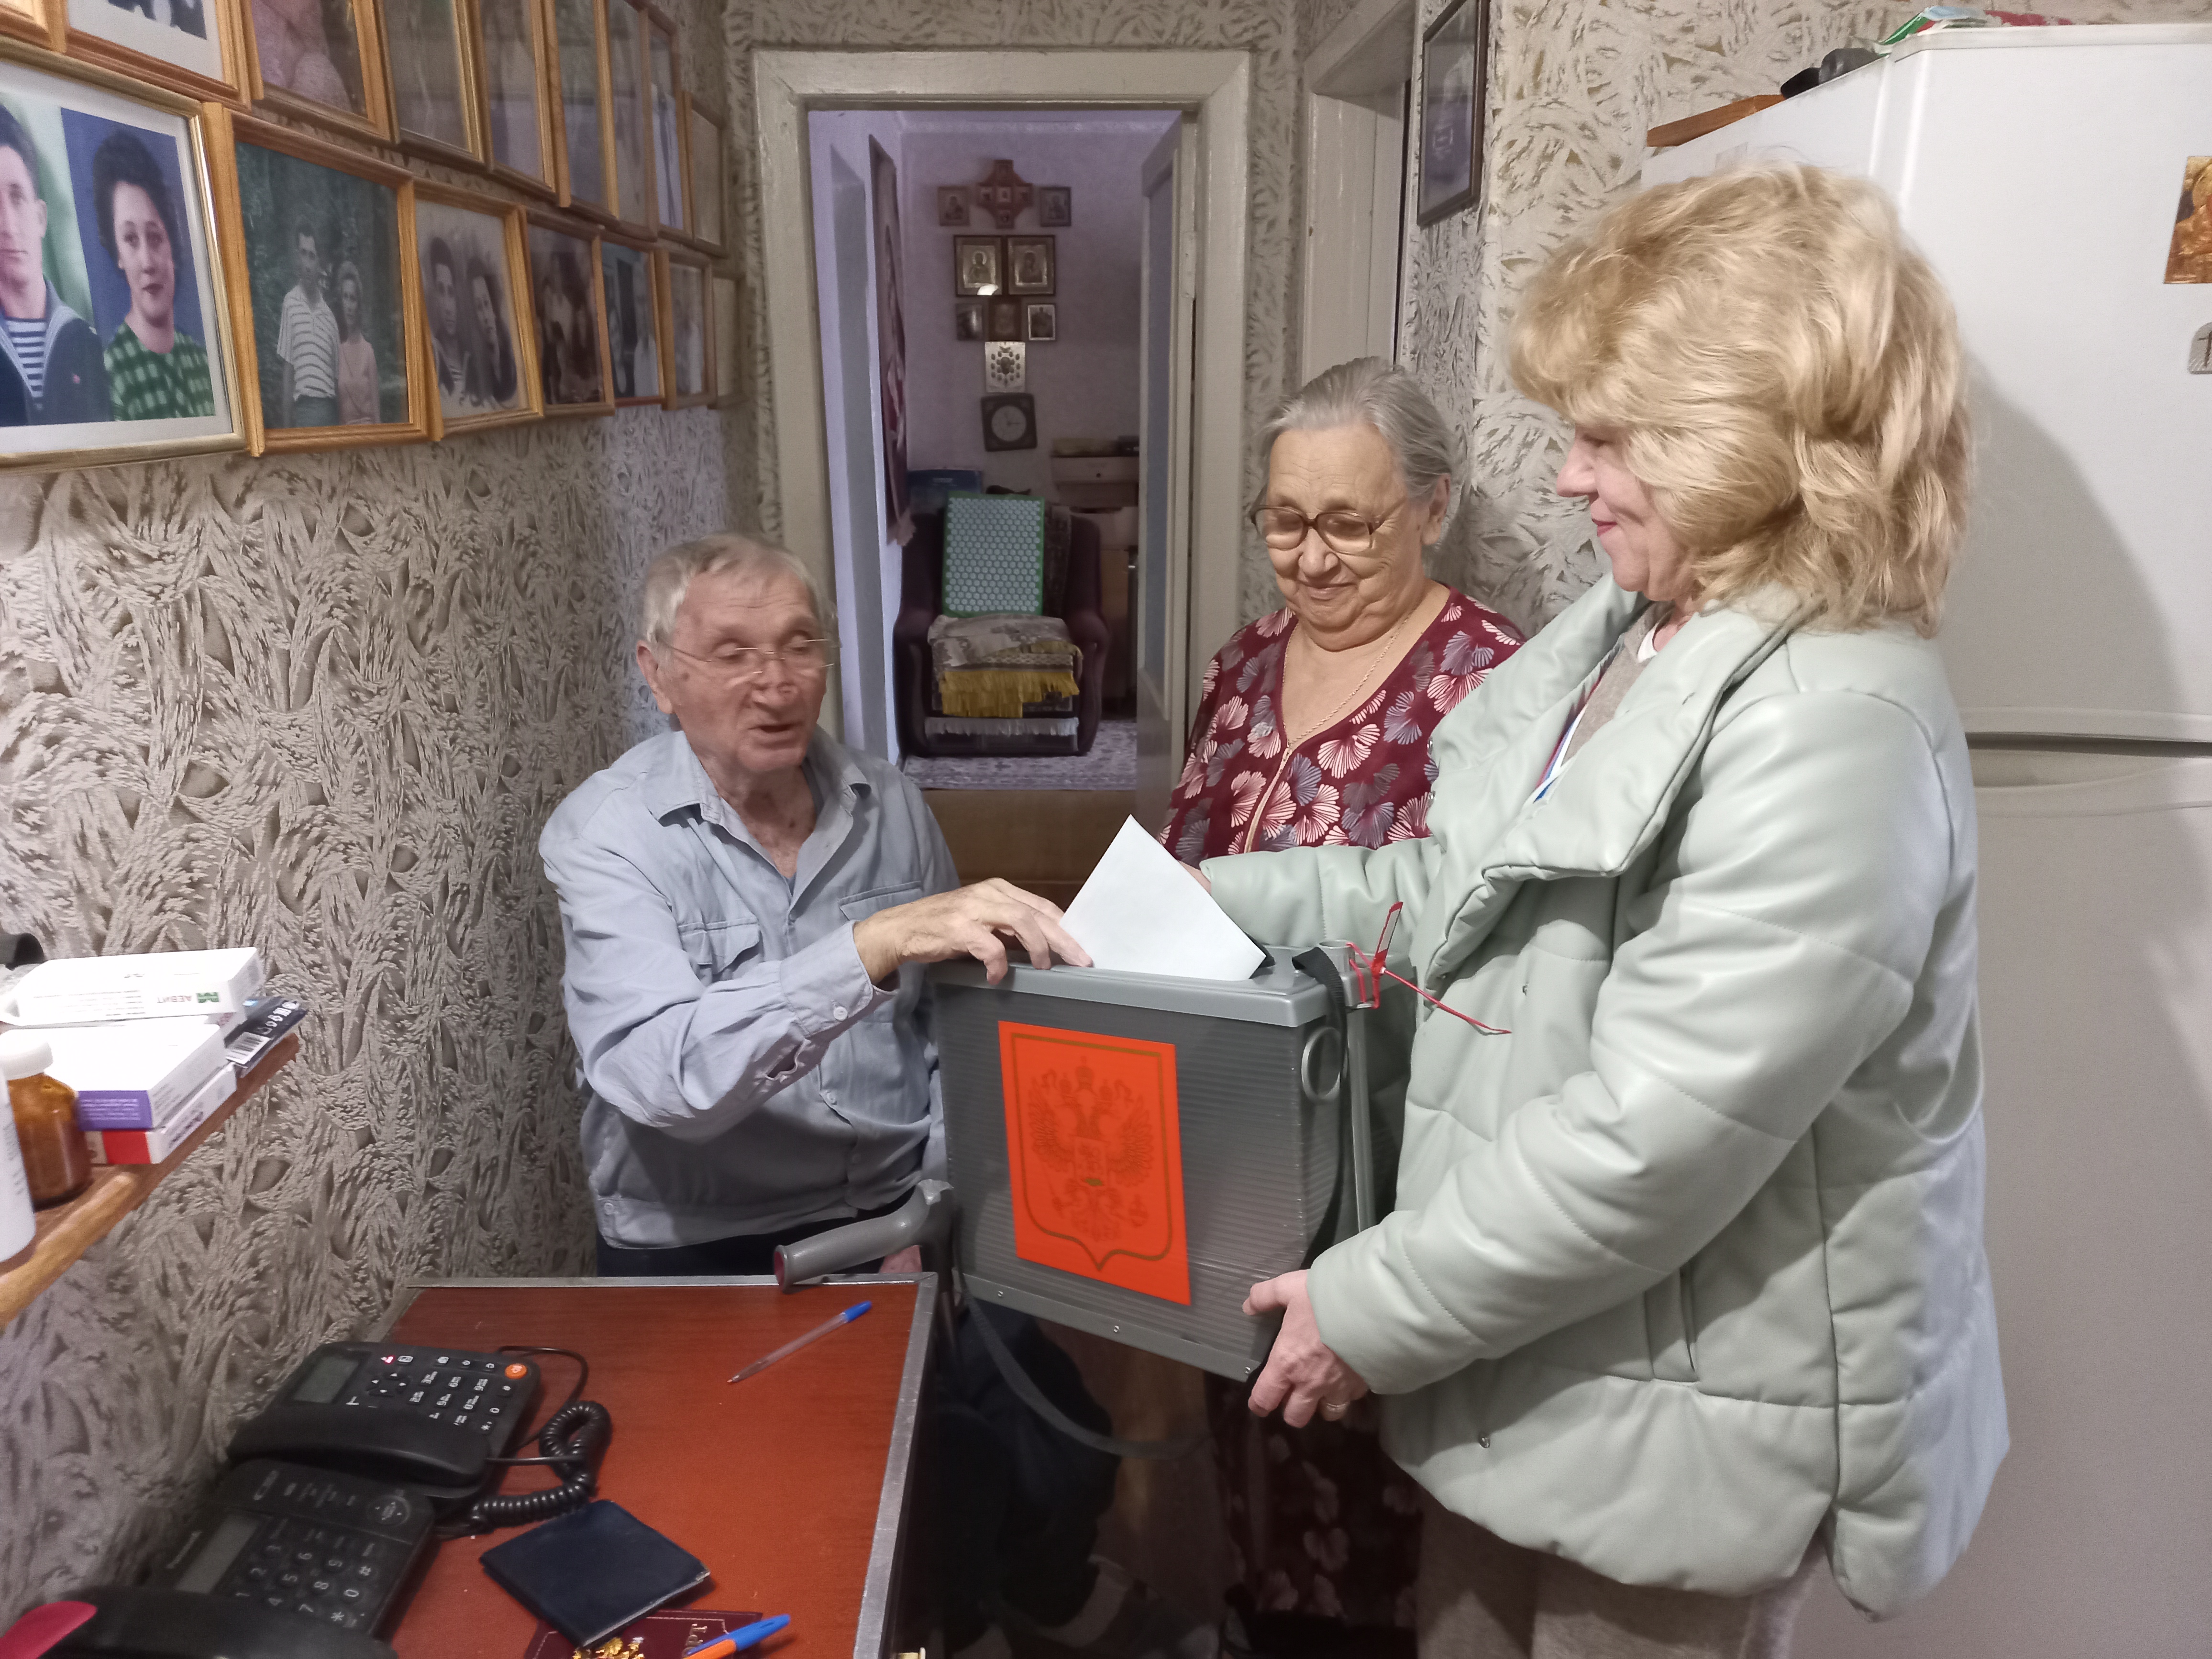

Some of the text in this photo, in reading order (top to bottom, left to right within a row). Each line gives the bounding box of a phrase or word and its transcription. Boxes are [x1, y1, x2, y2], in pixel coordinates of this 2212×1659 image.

[157, 994, 192, 1004] АЕВИТ
[282, 1574, 298, 1582] 5
[299, 1604, 314, 1613] 7
[314, 1581, 329, 1590] 8
[343, 1589, 359, 1597] 0
